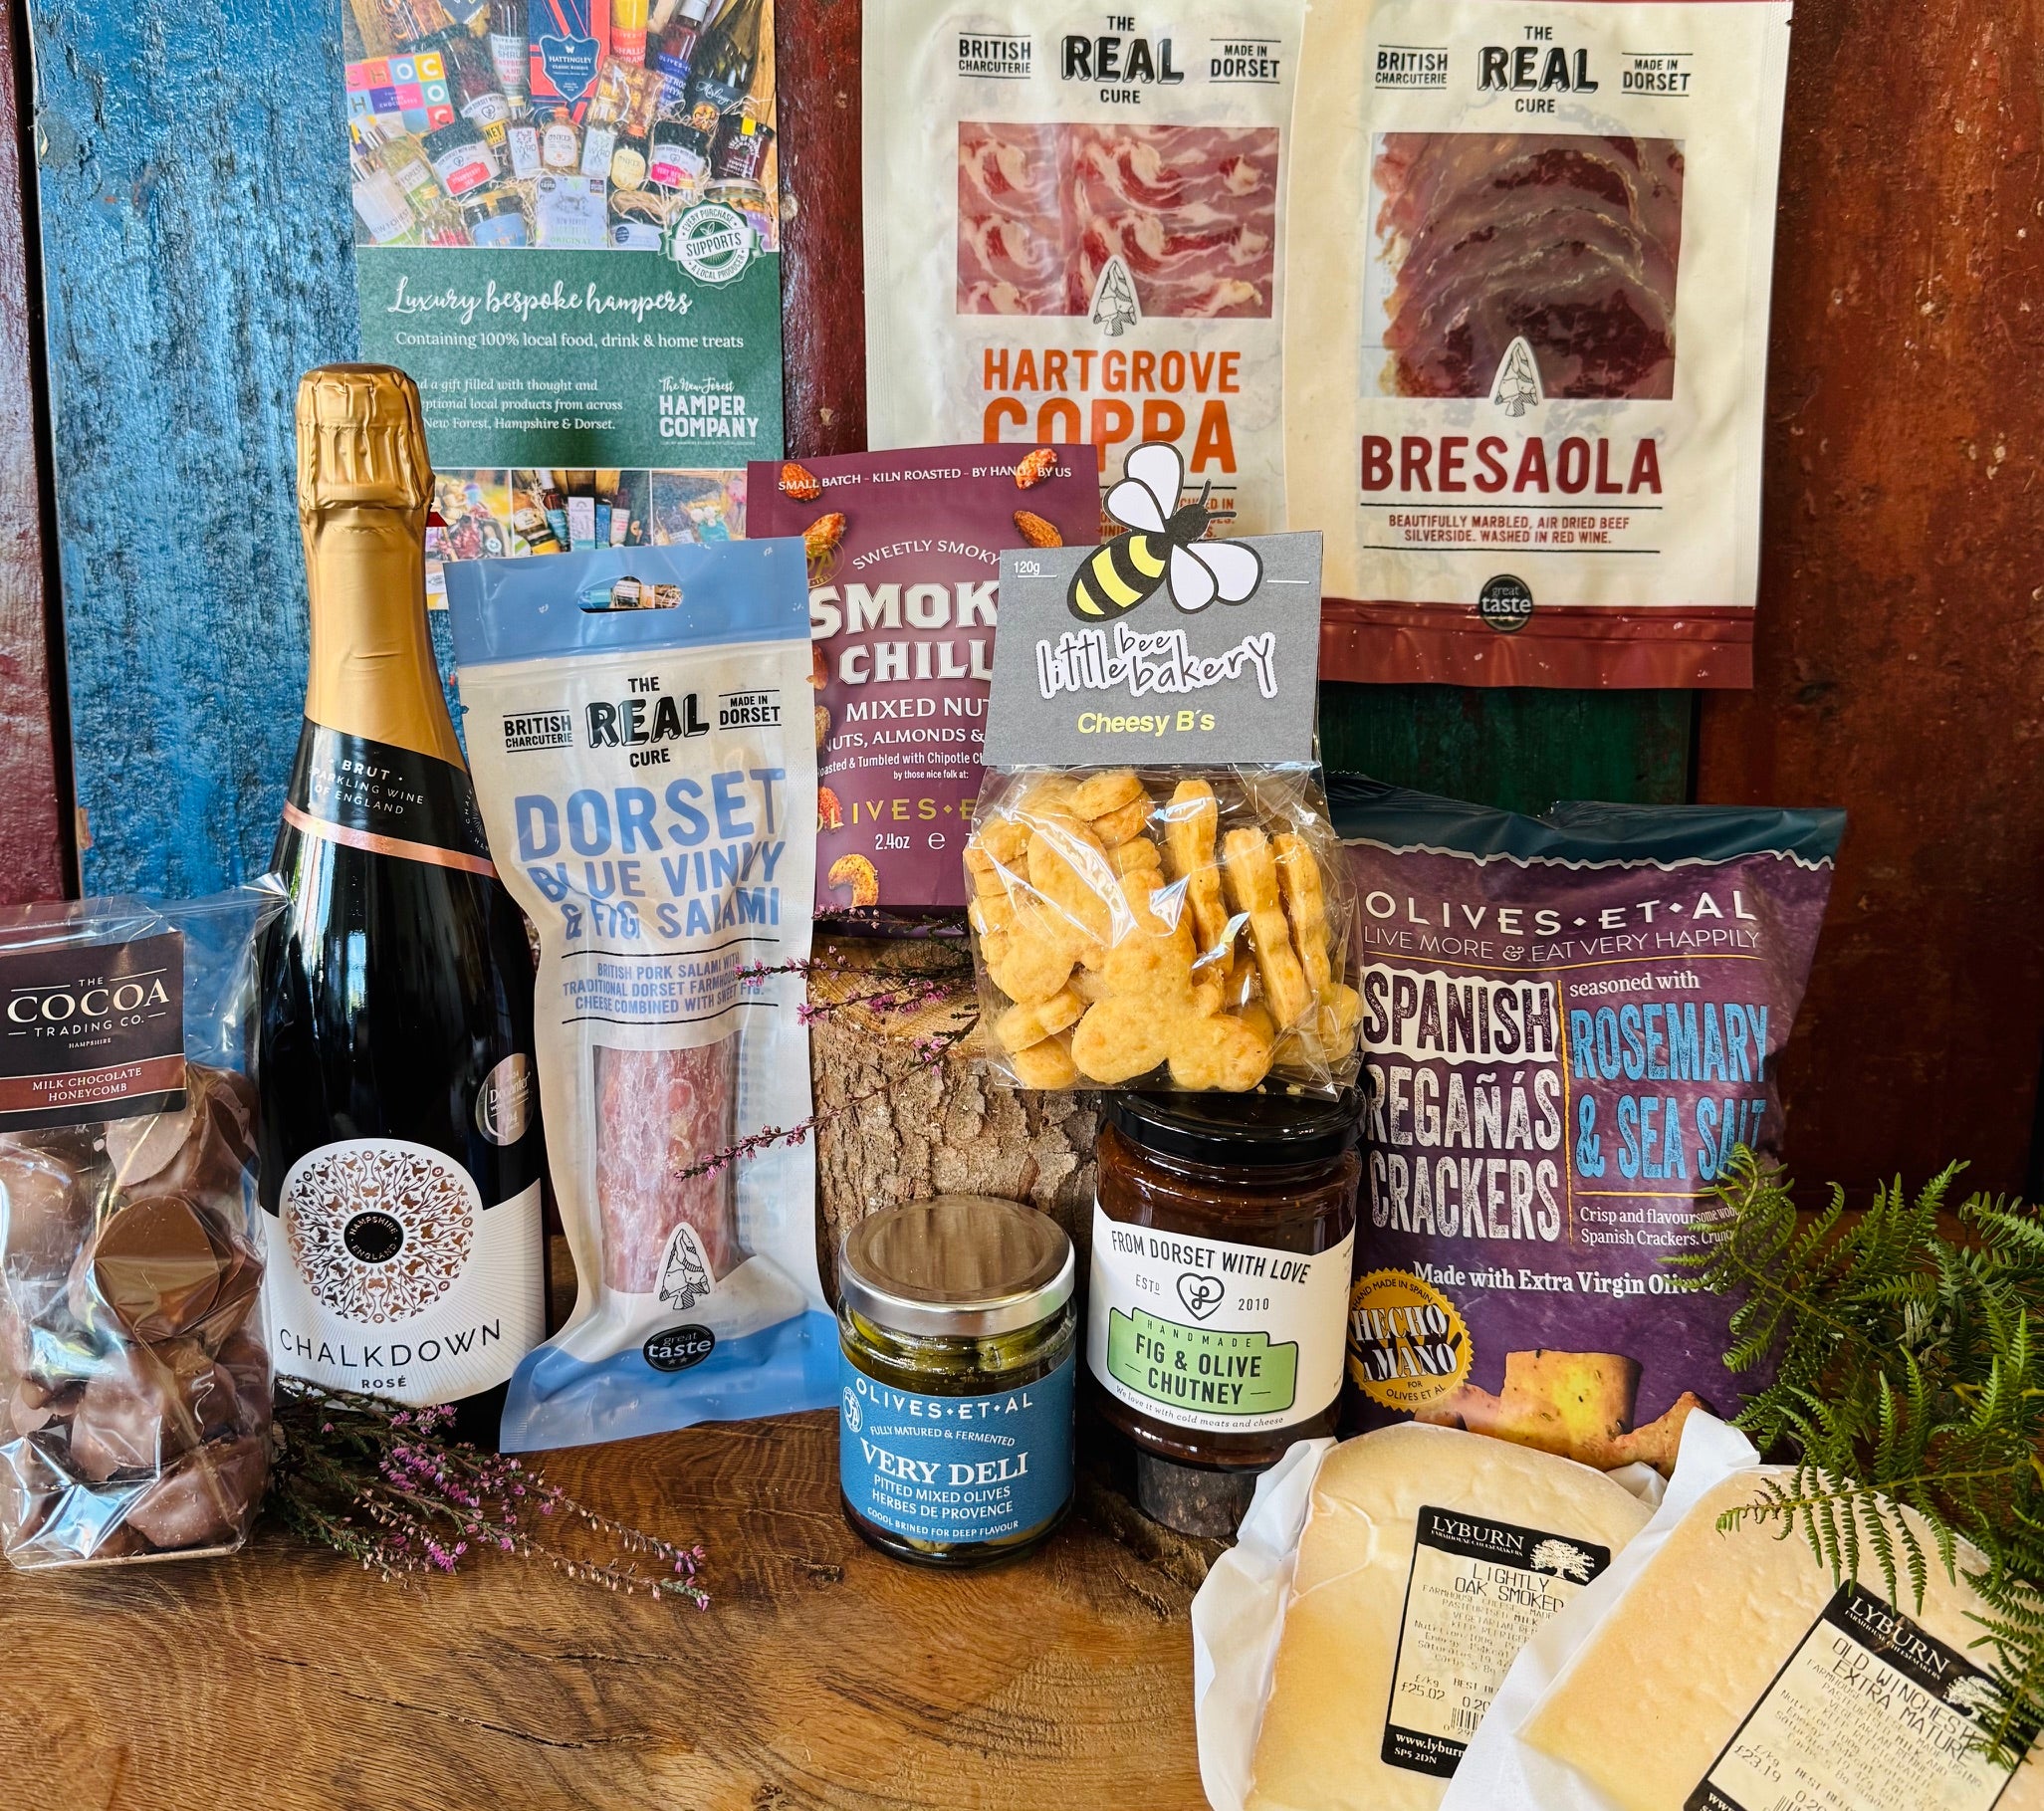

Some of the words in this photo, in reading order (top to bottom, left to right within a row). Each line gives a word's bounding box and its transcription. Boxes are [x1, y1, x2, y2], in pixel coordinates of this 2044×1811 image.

[1107, 16, 1135, 32] THE
[1524, 26, 1552, 40] THE
[960, 39, 1031, 61] BRITISH
[1061, 35, 1185, 85] REAL
[1224, 45, 1253, 57] MADE
[1257, 45, 1267, 57] IN
[959, 60, 1030, 74] CHARCUTERIE
[1211, 59, 1279, 79] DORSET
[1377, 52, 1448, 71] BRITISH
[1476, 46, 1598, 94] REAL
[1635, 59, 1663, 71] MADE
[1667, 59, 1678, 71] IN
[1375, 71, 1447, 86] CHARCUTERIE
[1622, 72, 1691, 92] DORSET
[1100, 89, 1141, 105] CURE
[1515, 99, 1555, 113] CURE
[682, 215, 700, 232] EVERY
[700, 208, 735, 224] PURCHASE
[686, 232, 742, 257] SUPPORTS
[386, 276, 482, 326] Luxury
[486, 279, 583, 323] bespoke
[586, 282, 693, 324] hampers
[396, 332, 477, 348] Containing
[480, 333, 519, 347] 100%
[523, 333, 557, 347] local
[561, 334, 597, 348] food,
[602, 334, 639, 347] drink
[643, 335, 655, 347] &
[658, 334, 698, 347] home
[702, 336, 744, 347] treats
[983, 348, 1241, 394] HARTGROVE
[442, 379, 461, 392] gift
[465, 379, 494, 392] filled
[498, 379, 524, 390] with
[528, 380, 572, 393] thought
[574, 380, 597, 391] and
[471, 399, 498, 409] local
[502, 399, 552, 412] products
[555, 399, 582, 412] from
[659, 395, 746, 415] HAMPER
[423, 419, 448, 429] New
[453, 419, 491, 430] Forest,
[495, 419, 560, 432] Hampshire
[562, 419, 571, 429] &
[574, 419, 615, 430] Dorset.
[659, 417, 759, 438] COMPANY
[1361, 435, 1662, 494] BRESAOLA
[778, 479, 818, 491] SMALL
[822, 474, 860, 488] BATCH
[872, 471, 900, 483] KILN
[904, 469, 961, 481] ROASTED
[972, 467, 988, 477] BY
[1037, 467, 1052, 477] BY
[1054, 467, 1071, 477] US
[1389, 515, 1467, 528] BEAUTIFULLY
[1472, 516, 1532, 530] MARBLED,
[1537, 517, 1557, 529] AIR
[1561, 517, 1596, 529] DRIED
[1599, 518, 1630, 530] BEEF
[1405, 530, 1476, 542] SILVERSIDE.
[1480, 530, 1529, 543] WASHED
[1535, 531, 1547, 543] IN
[1551, 531, 1574, 544] RED
[1578, 531, 1612, 544] WINE.
[1014, 561, 1040, 575] 120g
[1480, 594, 1531, 614] taste
[628, 676, 660, 692] THE
[730, 695, 755, 708] MADE
[758, 695, 769, 706] IN
[846, 699, 936, 722] MIXED
[585, 693, 710, 748] REAL
[719, 706, 781, 726] DORSET
[1077, 712, 1170, 737] Cheesy
[505, 732, 573, 749] CHARCUTERIE
[872, 729, 966, 745] ALMONDS
[971, 729, 985, 743] &
[629, 748, 671, 768] CURE
[849, 756, 855, 769] &
[858, 754, 899, 768] Tumbled
[902, 752, 925, 765] with
[928, 752, 970, 768] Chipotle
[387, 788, 424, 804] WINE
[514, 768, 786, 862] DORSET
[875, 833, 910, 850] 2.4oz
[1364, 925, 1413, 950] LIVE
[1419, 936, 1493, 960] MORE
[1501, 944, 1525, 962] &
[1531, 942, 1575, 963] EAT
[1578, 933, 1648, 956] VERY
[1656, 929, 1760, 949] HAPPILY
[597, 962, 632, 980] BRITISH
[636, 964, 673, 980] PORK
[678, 960, 721, 979] SALAMI
[722, 952, 740, 974] WITH
[78, 977, 104, 988] THE
[563, 982, 628, 997] TRADITIONAL
[633, 982, 684, 997] DORSET
[1569, 973, 1654, 998] seasoned
[1655, 971, 1701, 991] with
[7, 979, 169, 1023] COCOA
[1363, 970, 1554, 1055] SPANISH
[34, 1019, 113, 1037] TRADING
[120, 1015, 144, 1027] CO.
[68, 1037, 112, 1048] HAMPSHIRE
[1570, 1002, 1768, 1083] ROSEMARY
[32, 1079, 64, 1091] MILK
[68, 1067, 142, 1087] CHOCOLATE
[49, 1083, 127, 1102] HONEYCOMB
[1370, 1149, 1560, 1243] CRACKERS
[349, 1216, 398, 1235] HAMPSHIRE
[1580, 1207, 1616, 1226] Crisp
[1619, 1209, 1644, 1224] and
[1647, 1207, 1718, 1225] flavoursome
[1581, 1229, 1635, 1245] Spanish
[1637, 1231, 1700, 1245] Crackers.
[351, 1244, 396, 1260] ENGLAND
[1111, 1230, 1144, 1256] FROM
[1149, 1239, 1216, 1269] DORSET
[1222, 1250, 1266, 1277] WITH
[1269, 1257, 1311, 1285] LOVE
[1414, 1260, 1465, 1287] Made
[1468, 1266, 1514, 1291] with
[1518, 1269, 1573, 1293] Extra
[1576, 1271, 1645, 1298] Virgin
[280, 1319, 500, 1368] CHALKDOWN
[648, 1340, 711, 1358] taste
[1136, 1333, 1165, 1364] FIG
[1174, 1350, 1188, 1372] &
[1199, 1353, 1262, 1378] OLIVE
[361, 1375, 407, 1389] ROSÉ
[1148, 1367, 1244, 1405] CHUTNEY
[870, 1425, 894, 1436] FULLY
[895, 1426, 942, 1438] MATURED
[944, 1429, 953, 1439] &
[956, 1430, 1016, 1447] FERMENTED
[860, 1438, 941, 1483] VERY
[949, 1452, 1028, 1485] DELI
[874, 1474, 913, 1497] PITTED
[916, 1487, 960, 1503] MIXED
[964, 1485, 1011, 1502] OLIVES
[872, 1489, 916, 1515] HERBES
[920, 1504, 938, 1518] DE
[942, 1501, 1014, 1519] PROVENCE
[1433, 1515, 1524, 1550] LYBURN
[1849, 1596, 1950, 1674] LYBURN
[1401, 1683, 1446, 1701] £25.02
